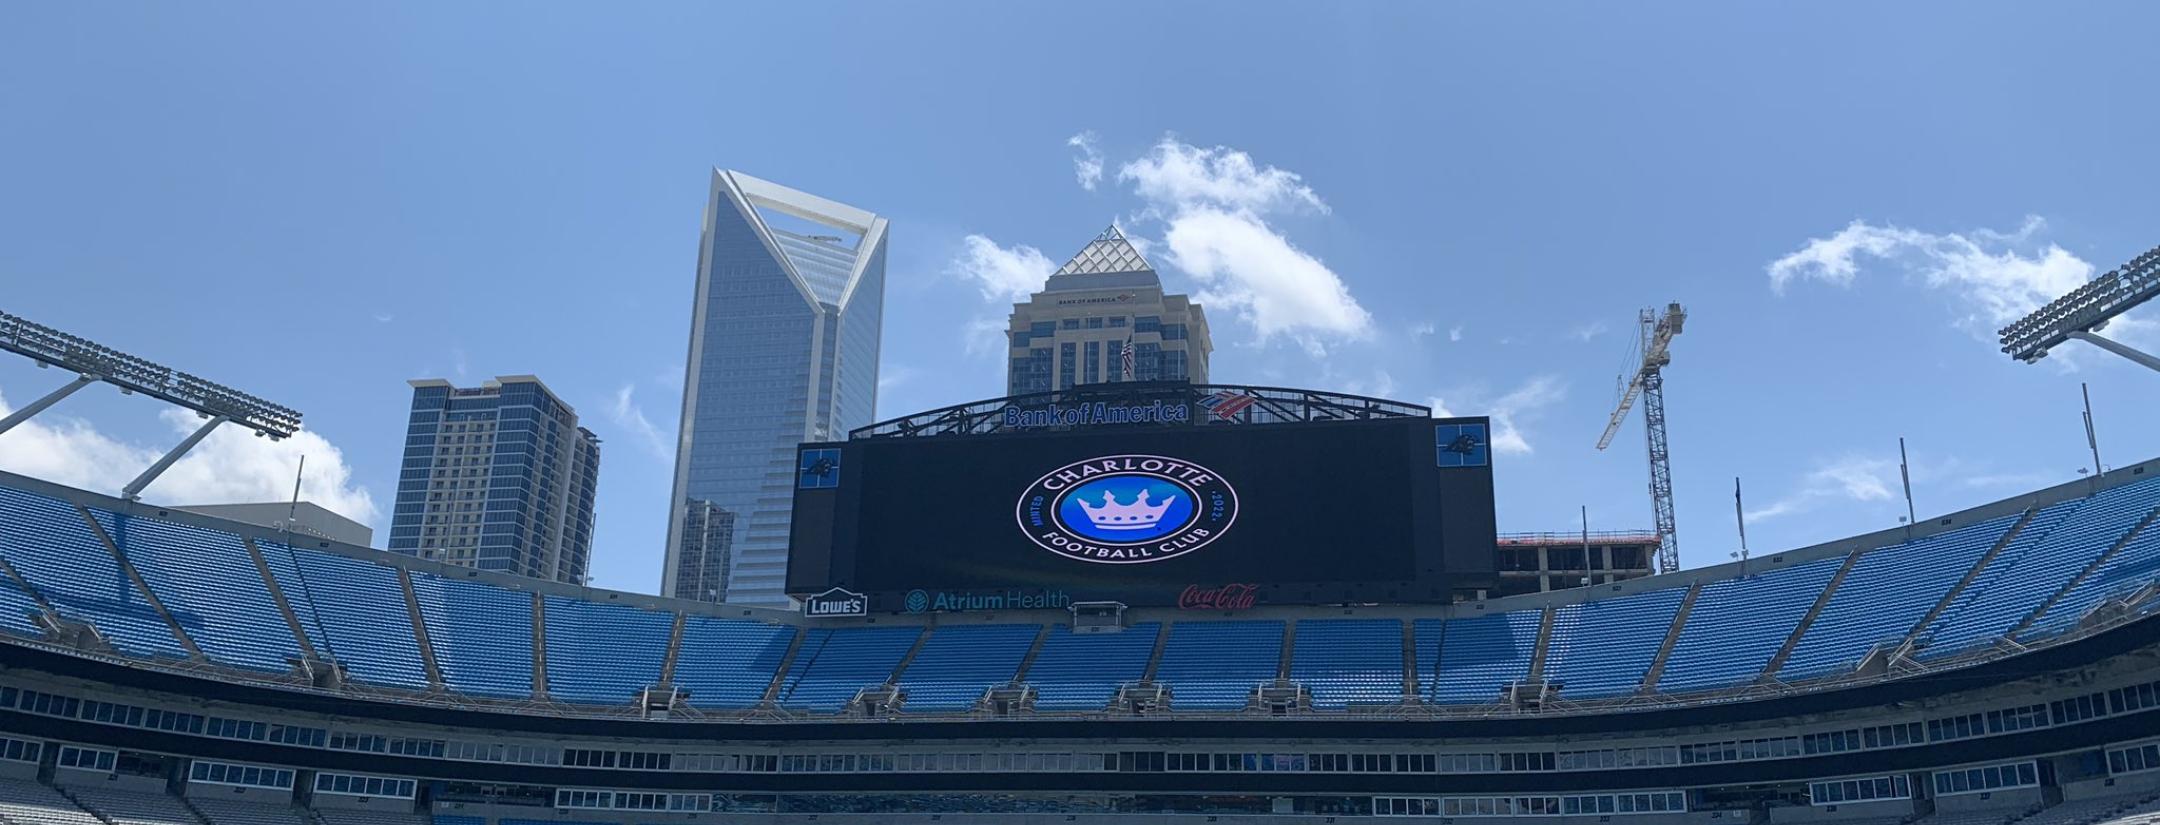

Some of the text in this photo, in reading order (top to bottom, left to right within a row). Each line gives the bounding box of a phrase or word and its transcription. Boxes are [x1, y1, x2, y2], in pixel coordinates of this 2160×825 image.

[1004, 400, 1188, 427] Bank of America
[1043, 458, 1214, 491] CHARLOTTE
[1029, 495, 1044, 527] MINTED
[1042, 527, 1211, 559] FOOTBALL CLUB
[811, 598, 862, 614] LOWE'S
[932, 590, 1070, 610] Atrium Health
